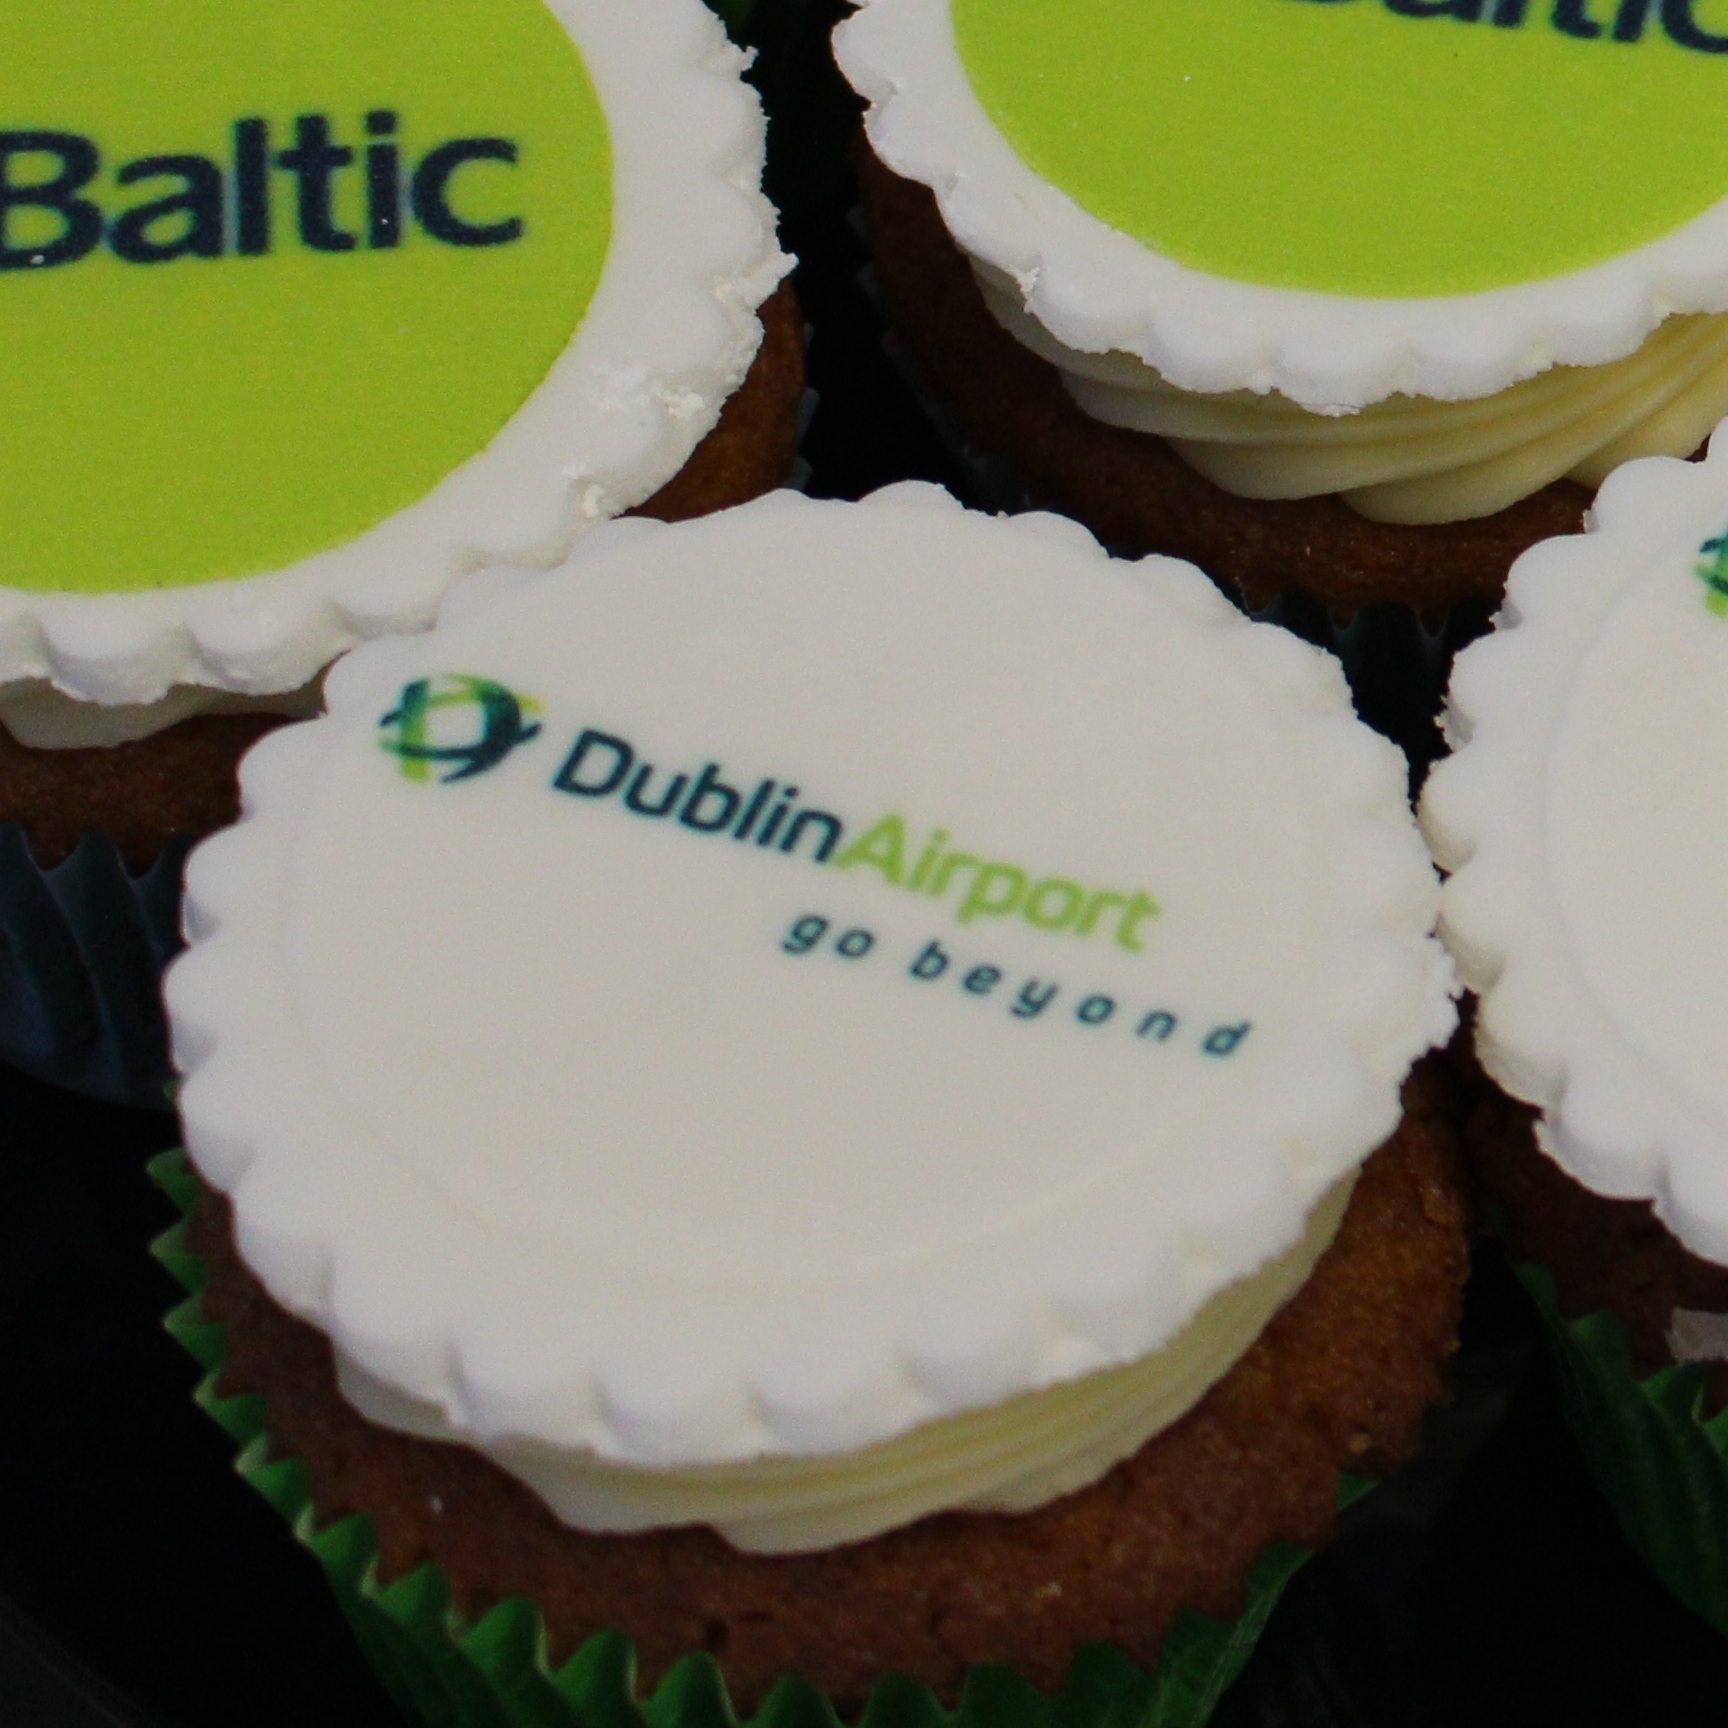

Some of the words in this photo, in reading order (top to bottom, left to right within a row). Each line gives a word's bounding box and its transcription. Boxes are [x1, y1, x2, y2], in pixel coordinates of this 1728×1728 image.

[0, 108, 524, 274] Baltic
[548, 726, 1161, 954] DublinAirport
[780, 912, 877, 962] go
[907, 938, 1252, 1059] beyond
